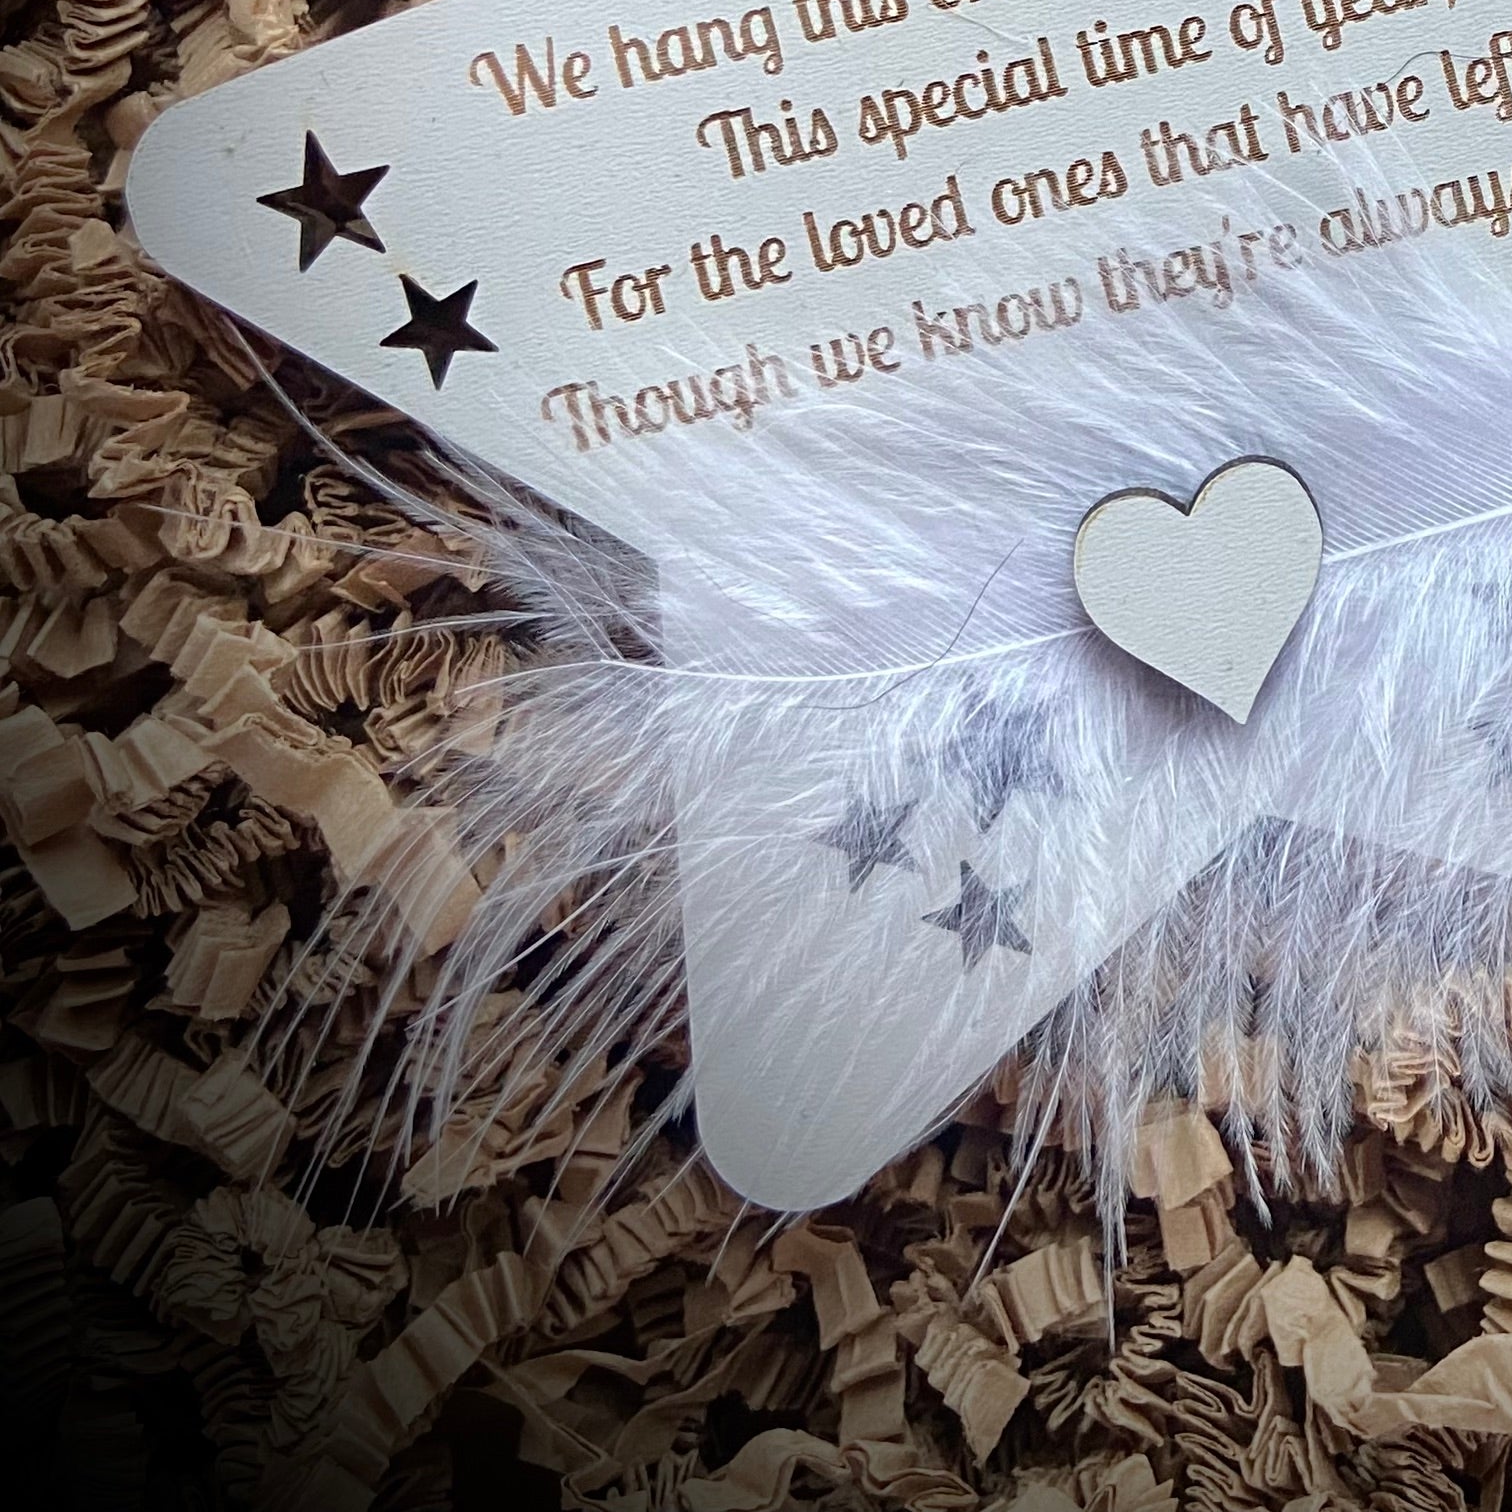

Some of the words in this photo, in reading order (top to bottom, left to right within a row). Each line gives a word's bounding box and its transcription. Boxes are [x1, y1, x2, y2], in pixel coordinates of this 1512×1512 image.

[470, 37, 599, 116] We
[608, 7, 784, 89] hang
[697, 99, 839, 179] This
[858, 37, 1068, 160] special
[1076, 16, 1213, 87] time
[560, 258, 672, 331] For
[690, 234, 793, 301] the
[804, 174, 975, 272] loved
[991, 151, 1128, 225] ones
[1140, 103, 1269, 187] that
[1277, 74, 1430, 154] have
[541, 343, 798, 453] Though
[810, 324, 901, 389] we
[912, 275, 1083, 361] know
[1098, 215, 1303, 314] they're
